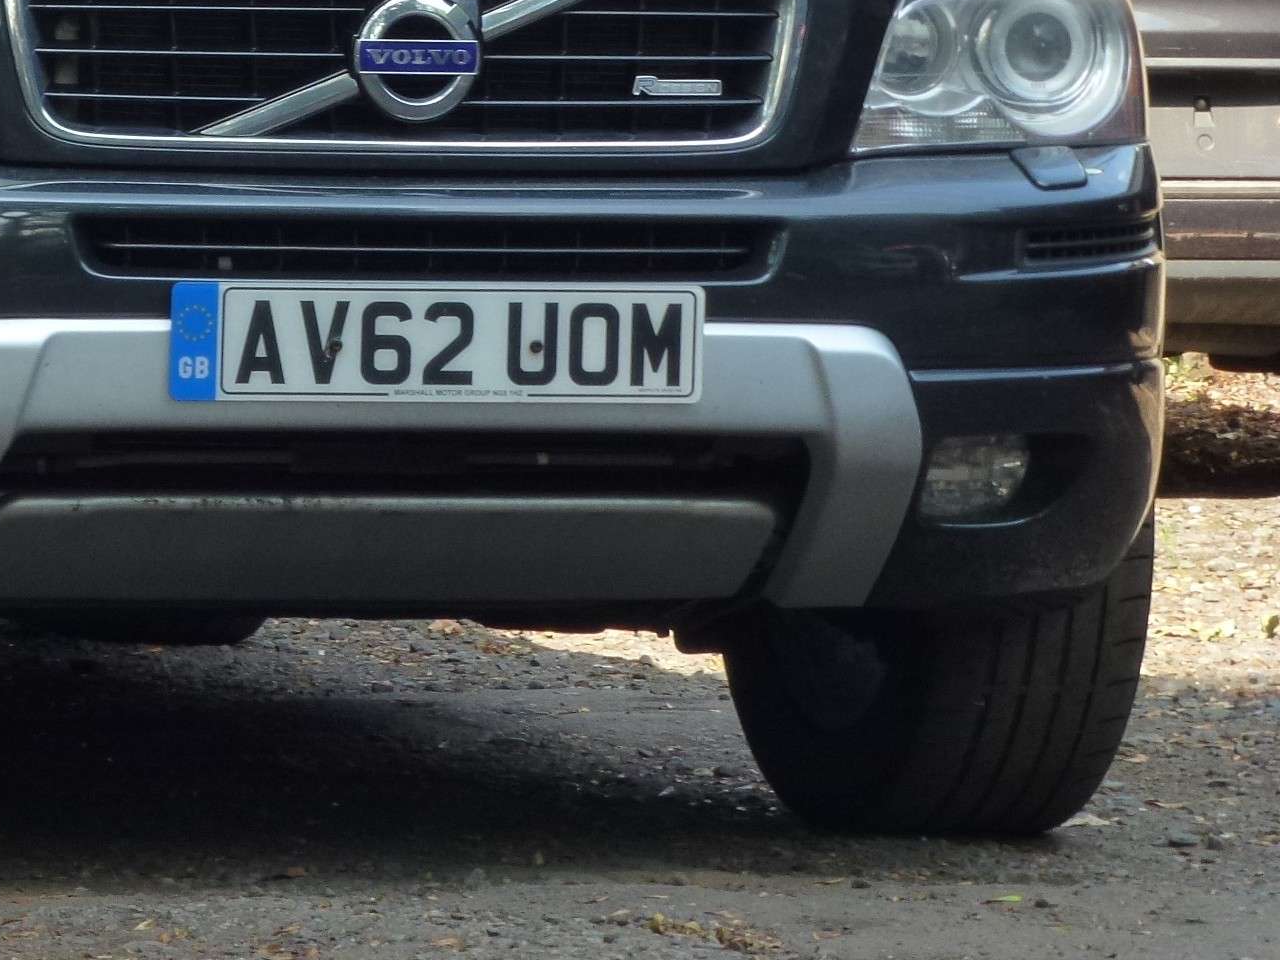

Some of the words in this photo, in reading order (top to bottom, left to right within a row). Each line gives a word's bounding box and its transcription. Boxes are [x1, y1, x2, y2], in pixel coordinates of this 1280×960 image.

[365, 48, 472, 65] VOLVO
[235, 300, 475, 385] AV62
[507, 302, 682, 387] UOM
[178, 355, 210, 379] GB
